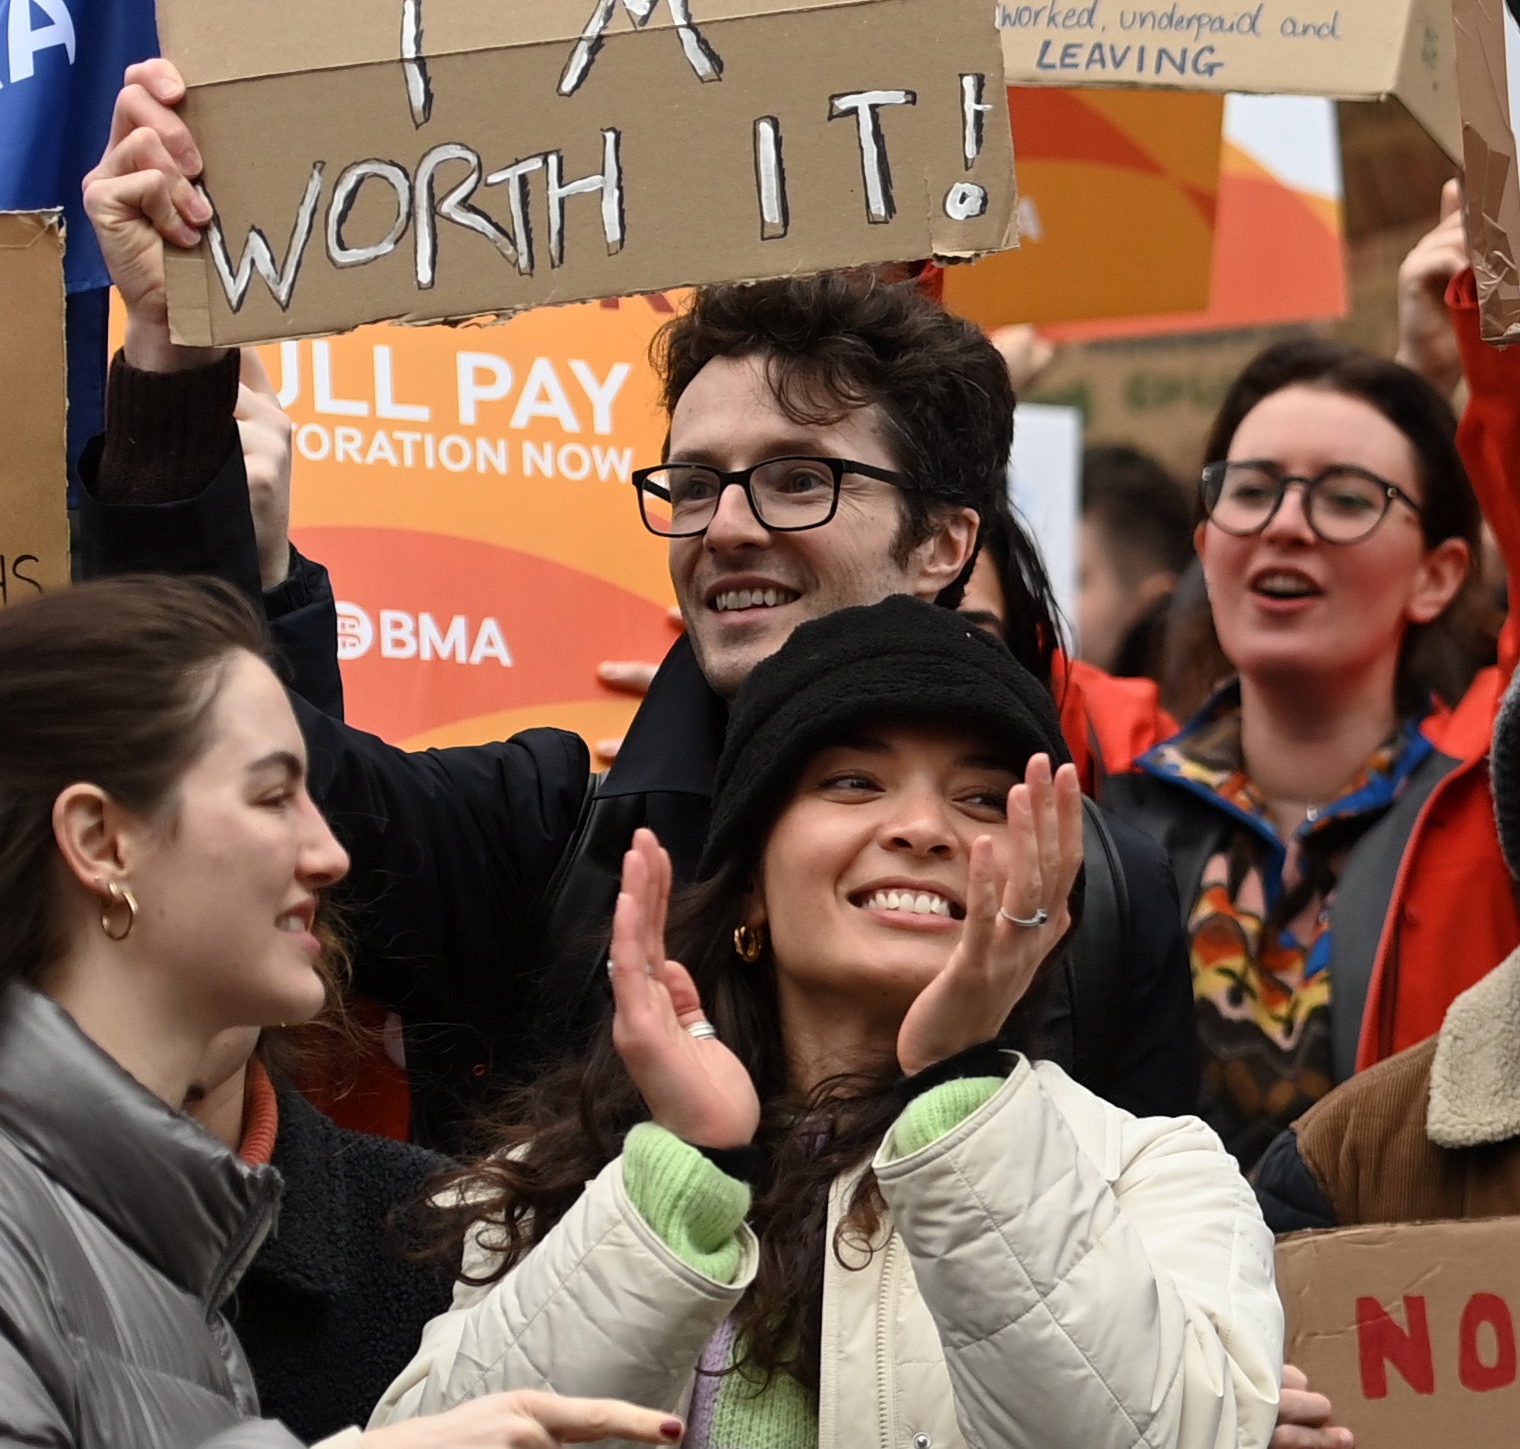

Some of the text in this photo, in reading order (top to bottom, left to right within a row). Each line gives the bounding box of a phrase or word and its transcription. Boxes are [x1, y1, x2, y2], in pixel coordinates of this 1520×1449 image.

[1119, 2, 1264, 42] underpaid
[1279, 10, 1342, 41] and
[1035, 39, 1225, 78] LEAVING
[197, 72, 995, 313] WORTH IT!
[456, 351, 633, 435] PAY
[293, 421, 633, 483] ORATION NOW
[379, 609, 514, 668] BMA
[1355, 1292, 1517, 1400] NO
